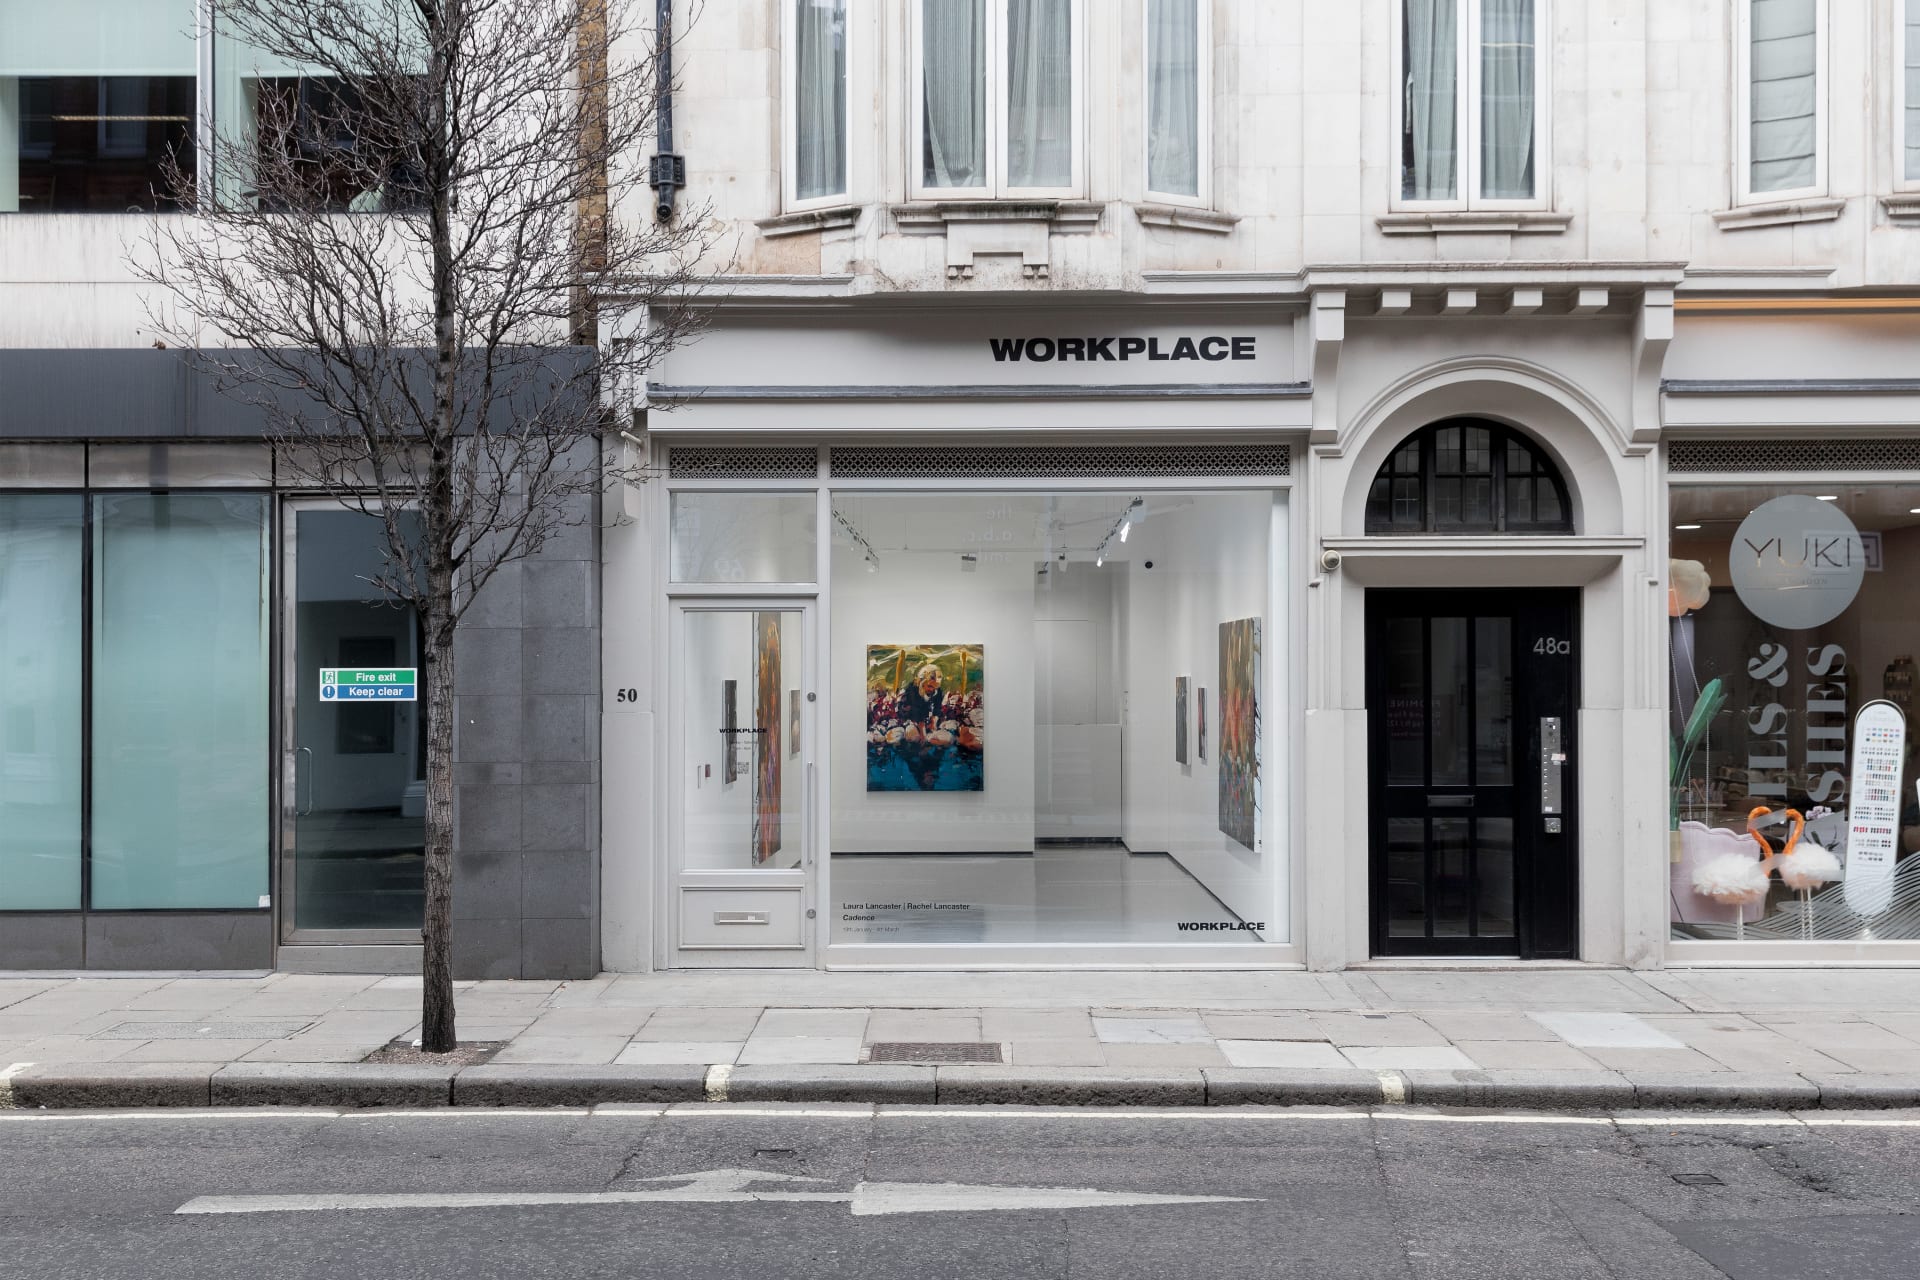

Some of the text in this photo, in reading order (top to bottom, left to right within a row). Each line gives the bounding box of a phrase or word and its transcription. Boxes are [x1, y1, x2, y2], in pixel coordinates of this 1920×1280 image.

[989, 336, 1256, 362] WORKPLACE
[1743, 536, 1852, 568] YUKI
[1533, 637, 1570, 655] 48a
[1748, 643, 1788, 687] &
[355, 673, 396, 682] Fire exit
[349, 687, 403, 698] Keep clear
[617, 688, 638, 703] 50
[1177, 922, 1265, 931] WORKPLACE
